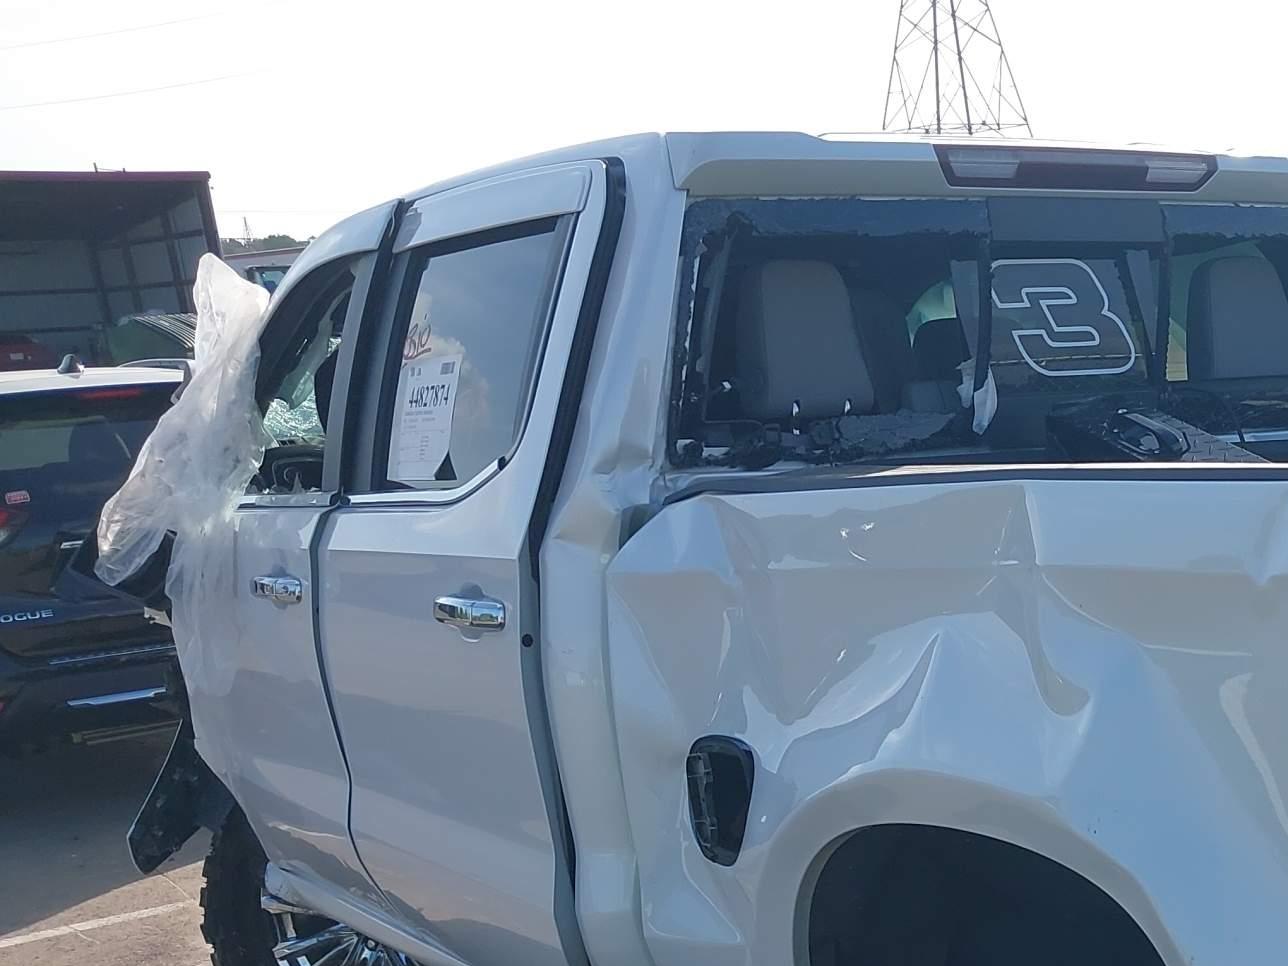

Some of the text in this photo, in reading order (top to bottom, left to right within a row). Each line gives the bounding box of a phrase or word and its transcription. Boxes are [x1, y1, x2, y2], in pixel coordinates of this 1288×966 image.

[989, 258, 1136, 377] 3
[408, 383, 451, 408] 44827874
[0, 609, 54, 623] OGUE
